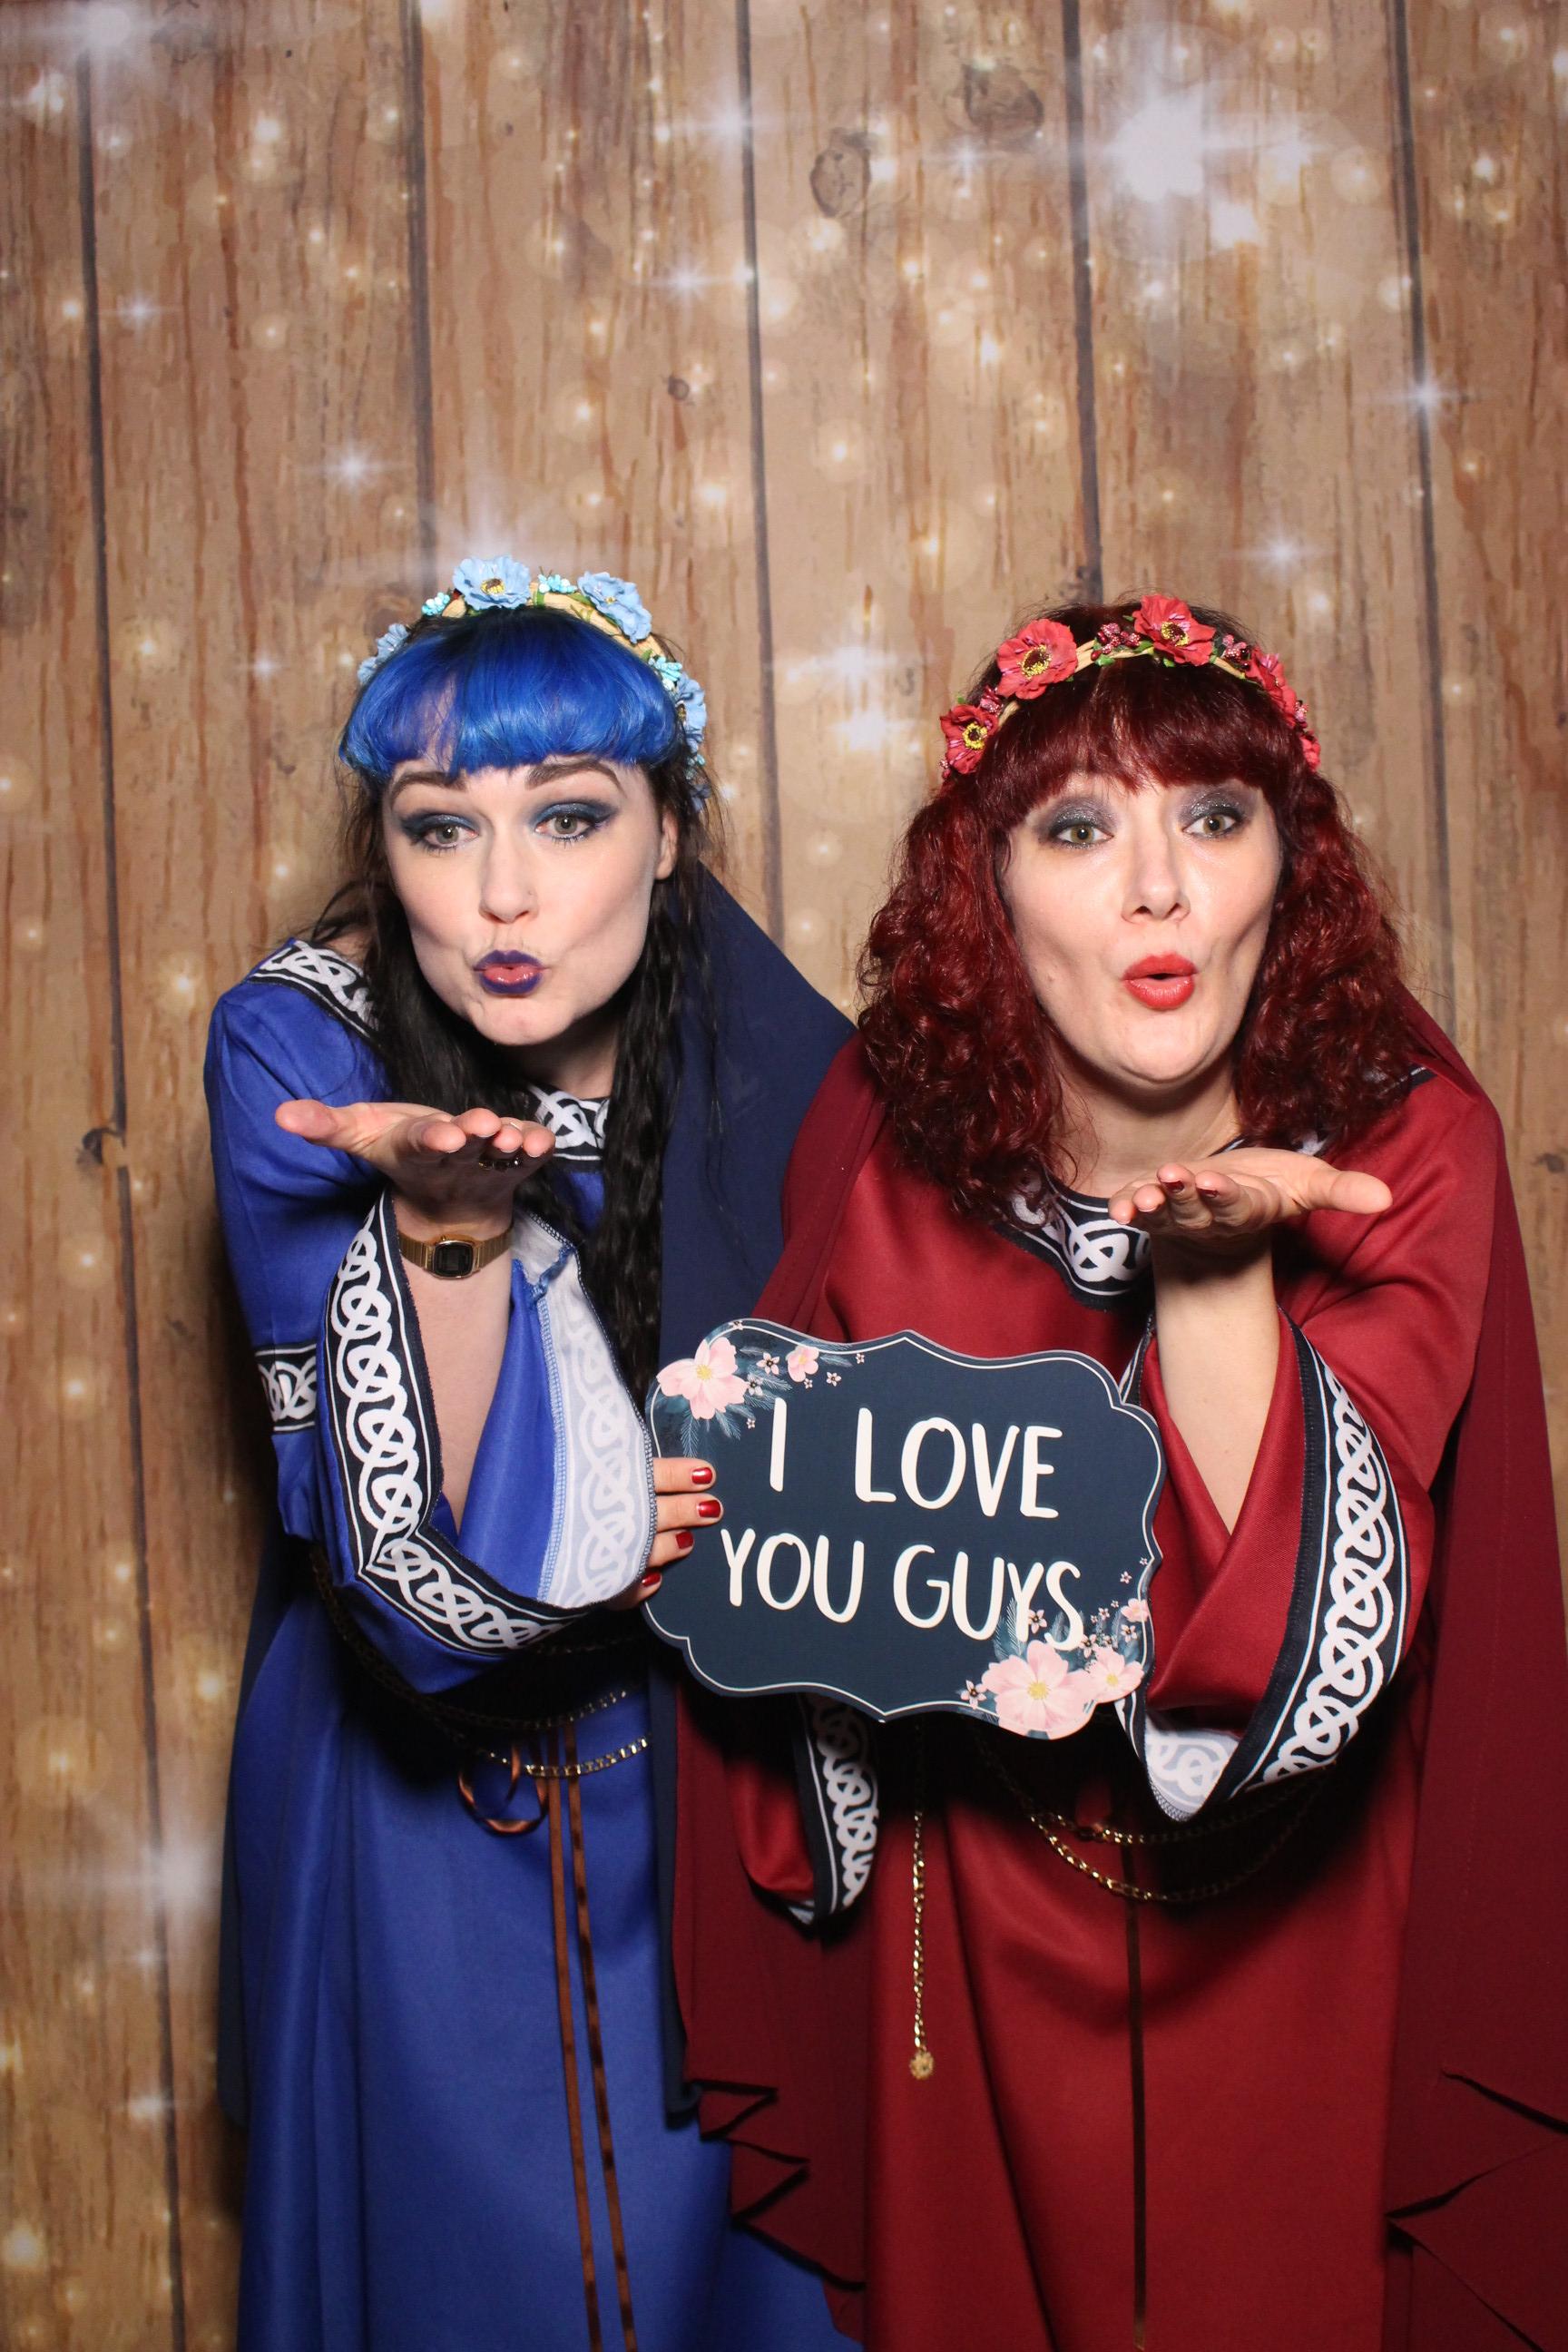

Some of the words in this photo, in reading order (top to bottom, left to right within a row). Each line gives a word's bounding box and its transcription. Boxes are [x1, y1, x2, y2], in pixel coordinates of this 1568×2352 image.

[769, 1396, 788, 1492] I
[855, 1407, 1063, 1518] LOVE
[720, 1528, 864, 1622] YOU
[893, 1544, 1084, 1651] GUYS
